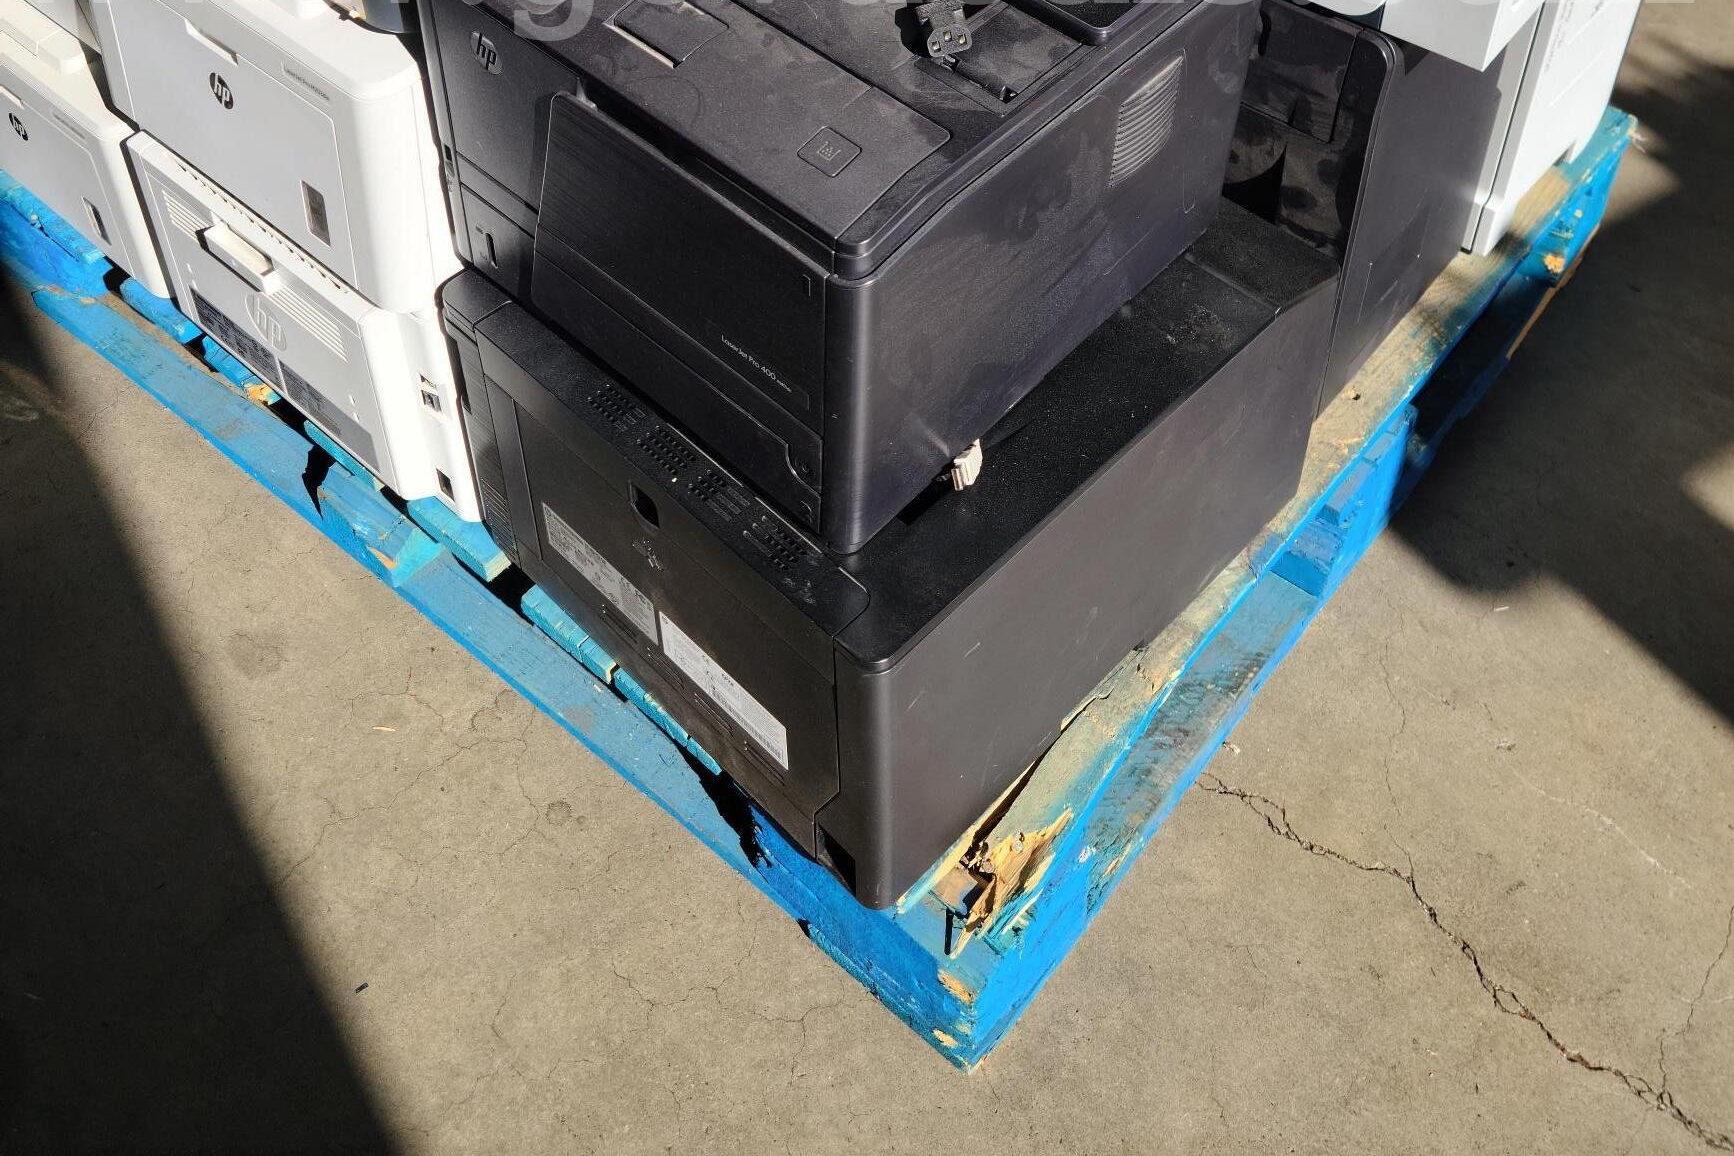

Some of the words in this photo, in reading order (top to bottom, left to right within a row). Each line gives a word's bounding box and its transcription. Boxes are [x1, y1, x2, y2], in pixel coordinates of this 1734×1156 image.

[475, 32, 498, 71] hp
[211, 73, 231, 108] hp
[11, 113, 27, 140] hp
[760, 365, 777, 381] 400
